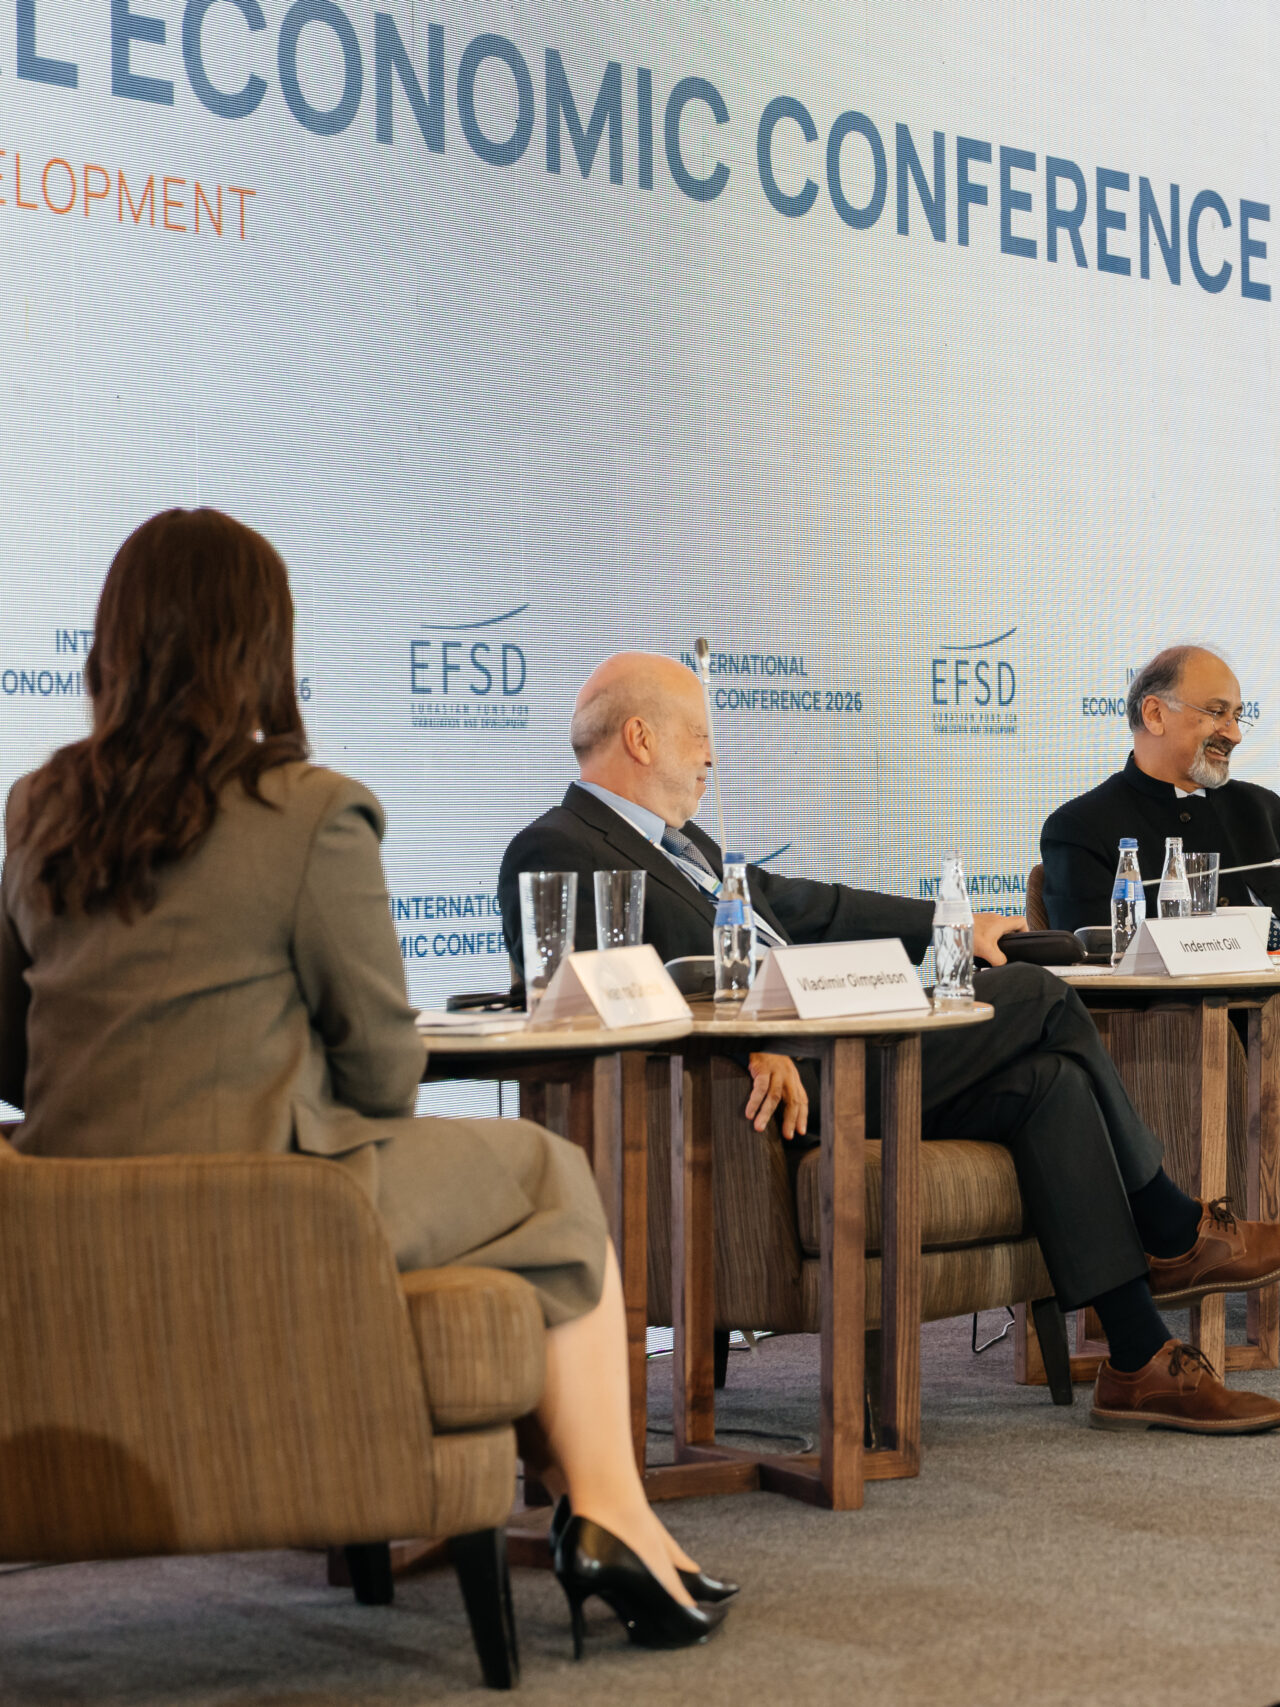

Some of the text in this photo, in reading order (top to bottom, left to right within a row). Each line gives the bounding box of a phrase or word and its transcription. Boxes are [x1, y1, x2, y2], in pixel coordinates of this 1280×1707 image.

[111, 0, 731, 203] ECONOMIC
[757, 95, 1272, 303] CONFERENCE
[0, 148, 257, 240] LOPMENT
[411, 639, 527, 696] EFSD
[680, 653, 807, 677] INERNATIONAL
[1, 669, 83, 696] ONOMI
[932, 658, 1016, 706] EFSD
[715, 688, 862, 713] CONFERENCE 2026
[1082, 697, 1127, 717] ECONO
[920, 874, 1027, 897] INTATIONAL
[392, 895, 502, 920] INTERNATIO
[433, 932, 509, 957] CONFER
[1179, 937, 1241, 953] Indermit Gill
[797, 971, 907, 992] Vladimir Gimpelson
